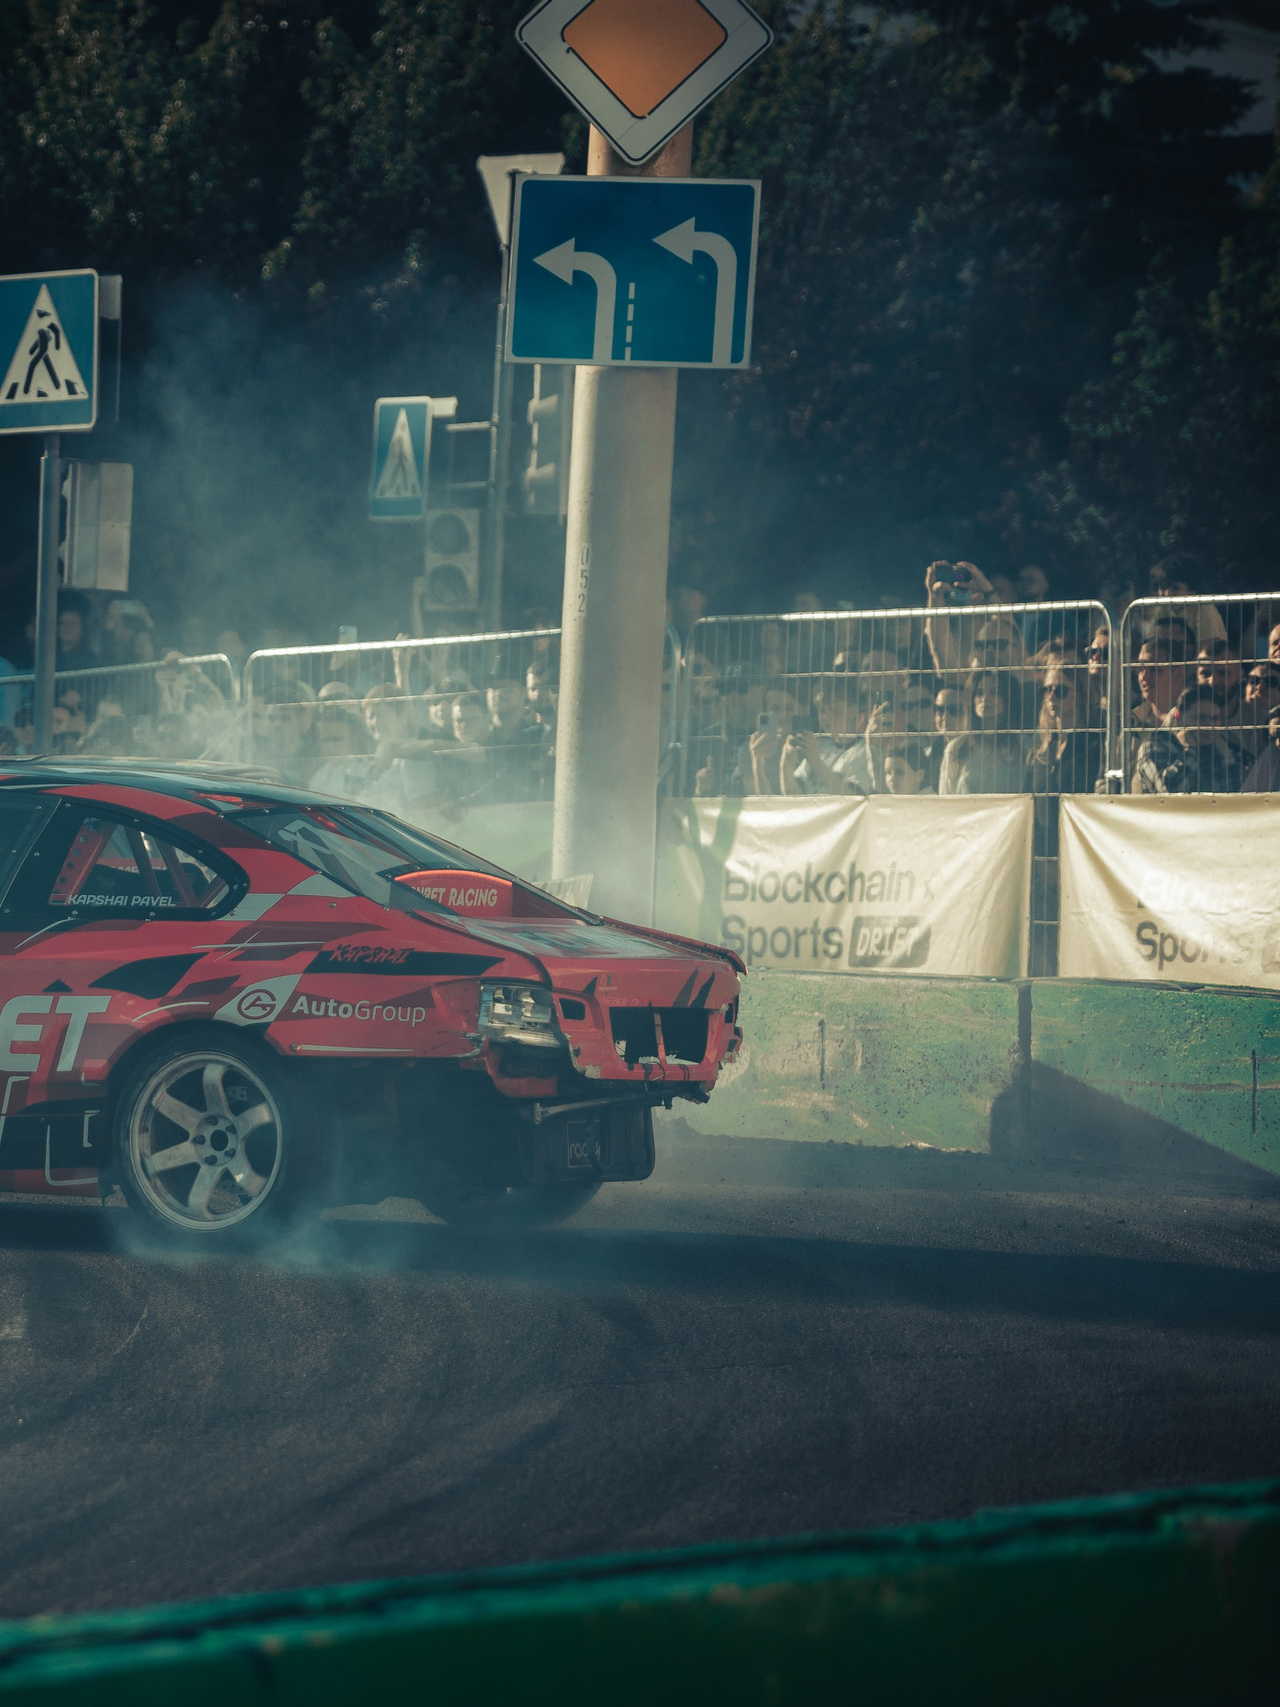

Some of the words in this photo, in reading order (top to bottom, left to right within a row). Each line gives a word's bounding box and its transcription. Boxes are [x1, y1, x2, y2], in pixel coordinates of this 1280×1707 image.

[67, 894, 128, 906] KAPSHAI
[131, 895, 177, 907] PAVEL
[447, 887, 498, 907] RACING
[720, 913, 844, 965] Sports
[328, 943, 415, 964] KAPSHAI
[291, 995, 426, 1028] AutoGroup
